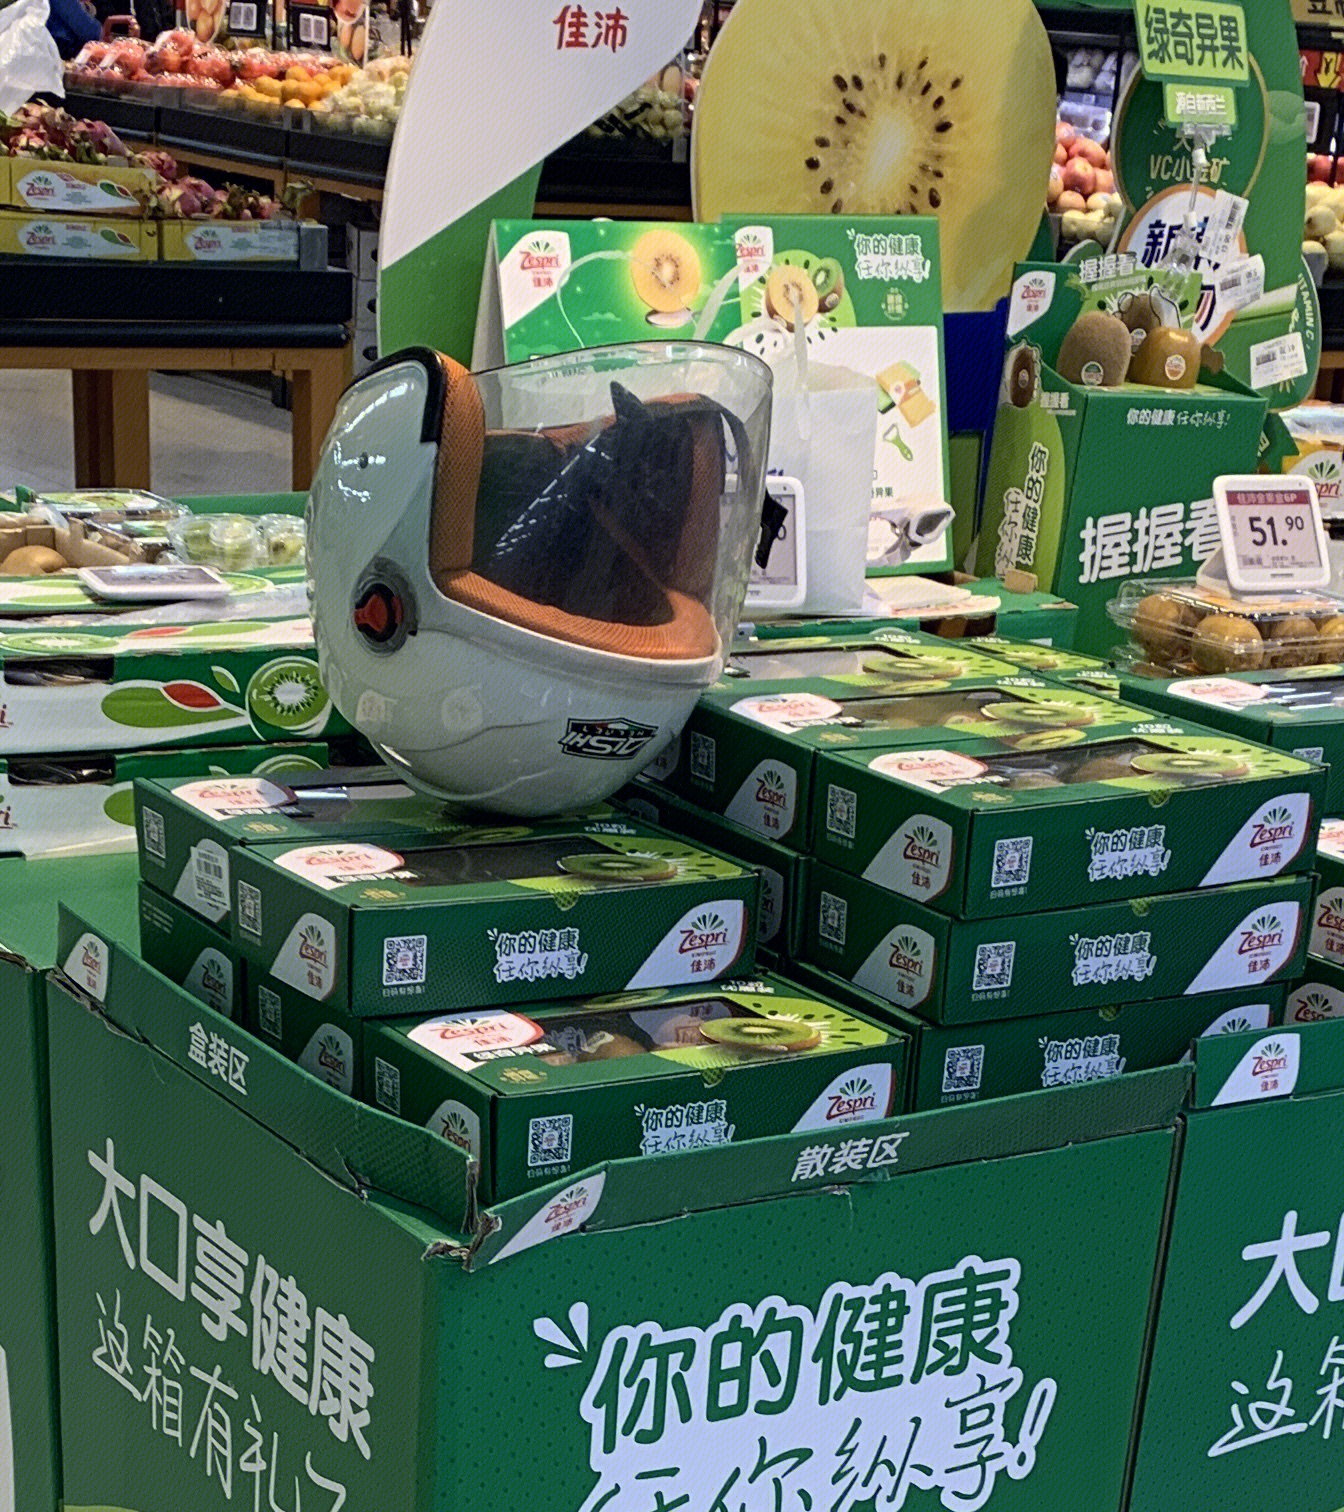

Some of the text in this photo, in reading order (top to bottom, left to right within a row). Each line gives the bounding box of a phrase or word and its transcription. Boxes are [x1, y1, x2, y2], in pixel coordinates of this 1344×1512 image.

[553, 7, 628, 52] 佳沛
[1144, 3, 1244, 69] 绿奇异果
[857, 236, 921, 255] 你的健康
[520, 251, 561, 271] Zespri
[1249, 516, 1304, 546] 51.90
[756, 778, 787, 809] Zespri
[1092, 827, 1163, 855] 你的健康
[1251, 819, 1294, 848] Zespri
[903, 832, 940, 867] Zespri
[1259, 852, 1282, 868] 佳沛
[299, 932, 328, 969] Zespri
[497, 929, 578, 955] 你的健康
[678, 925, 729, 955] Zespri
[1076, 933, 1150, 960] 你的健康
[1238, 930, 1282, 955] Zespri
[689, 957, 716, 975] 佳沛
[889, 943, 924, 976] Zespri
[430, 1023, 511, 1040] Zespri
[187, 1021, 251, 1096] 盒装区
[1045, 1036, 1120, 1062] 你的健康
[1252, 1055, 1287, 1076] Zespri
[644, 1101, 726, 1132] 你的健康
[827, 1092, 876, 1117] Zespri
[791, 1132, 910, 1184] 散装区
[545, 1192, 588, 1224] Zespri
[87, 1137, 376, 1460] 大口享健康
[592, 1265, 1012, 1455] 你的健康
